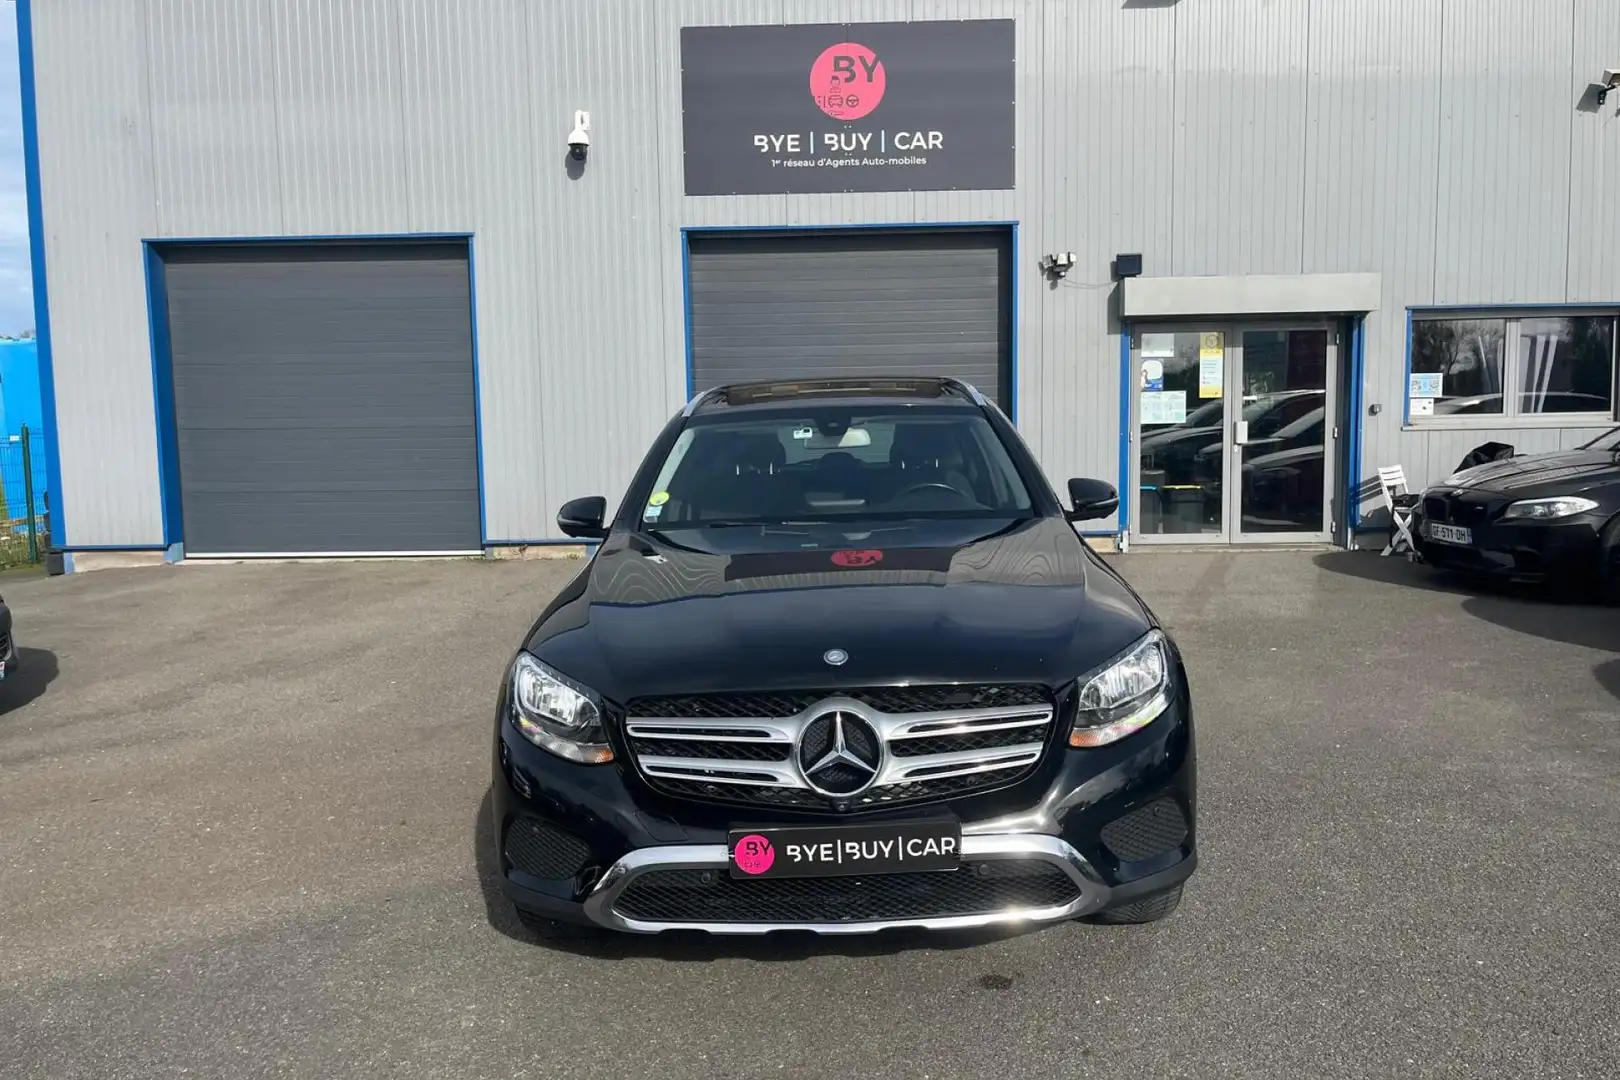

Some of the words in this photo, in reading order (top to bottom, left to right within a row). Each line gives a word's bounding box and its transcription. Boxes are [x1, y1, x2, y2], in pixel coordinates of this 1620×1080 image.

[833, 55, 880, 83] BY
[753, 134, 801, 153] BYE
[824, 132, 873, 151] BUY
[894, 131, 943, 150] CAR
[783, 158, 814, 167] réseau
[817, 158, 860, 168] d'Agents
[861, 157, 927, 166] Auto-mobiles
[746, 840, 771, 856] BY
[785, 843, 834, 863] BYE
[845, 840, 894, 860] BUY
[906, 837, 956, 857] CAR
